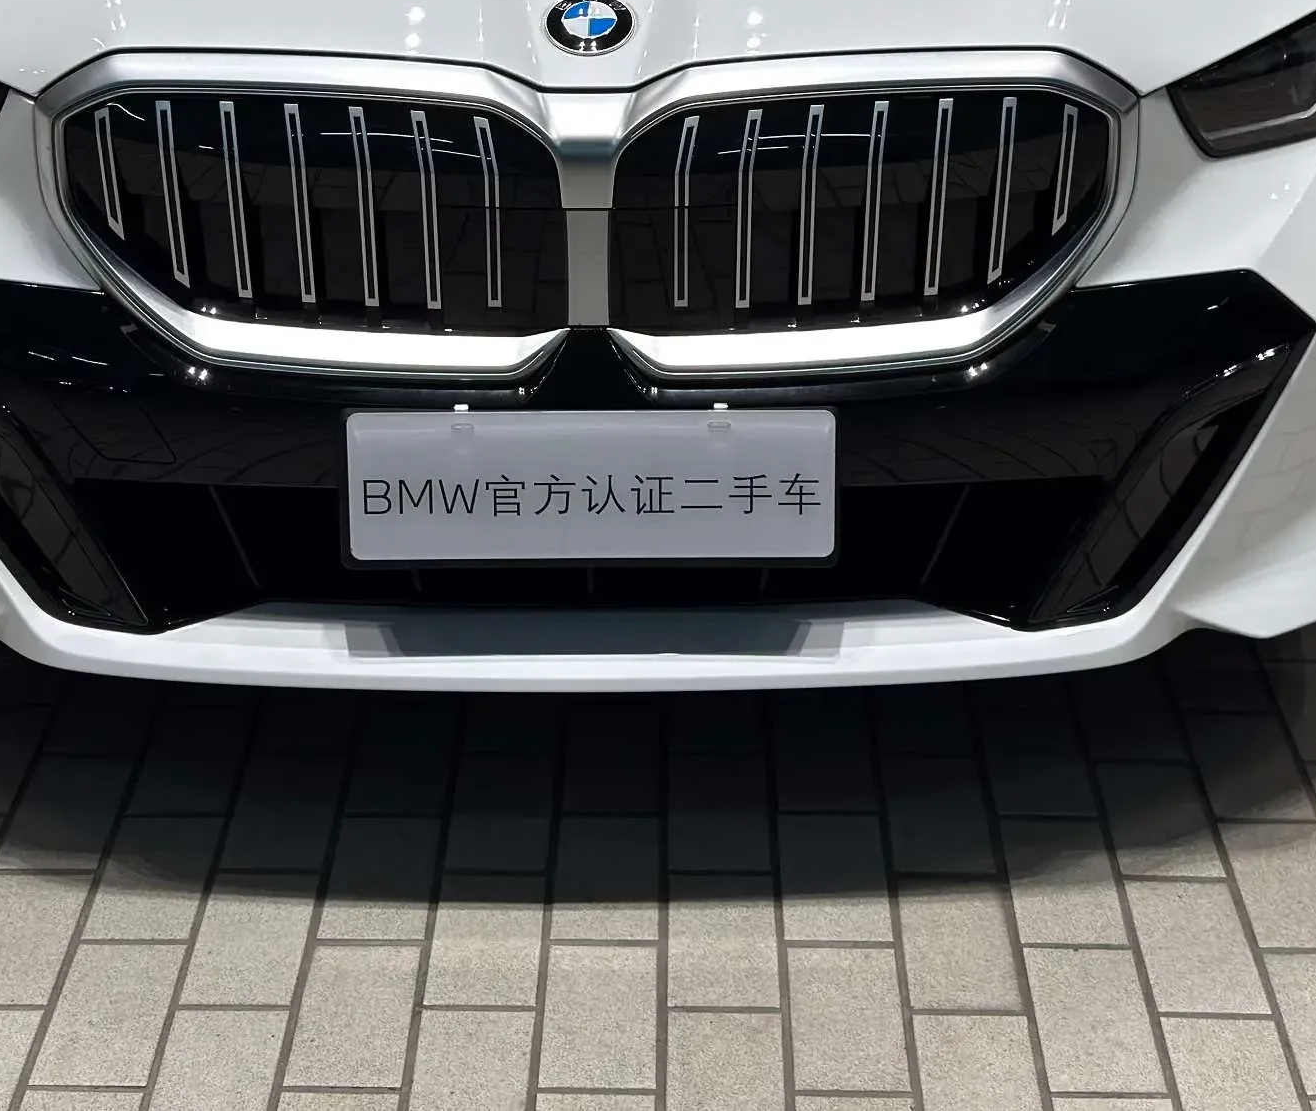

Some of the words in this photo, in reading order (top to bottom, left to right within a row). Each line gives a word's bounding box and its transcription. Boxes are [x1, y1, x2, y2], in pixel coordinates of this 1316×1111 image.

[361, 473, 823, 518] BMW官方认证二手车
